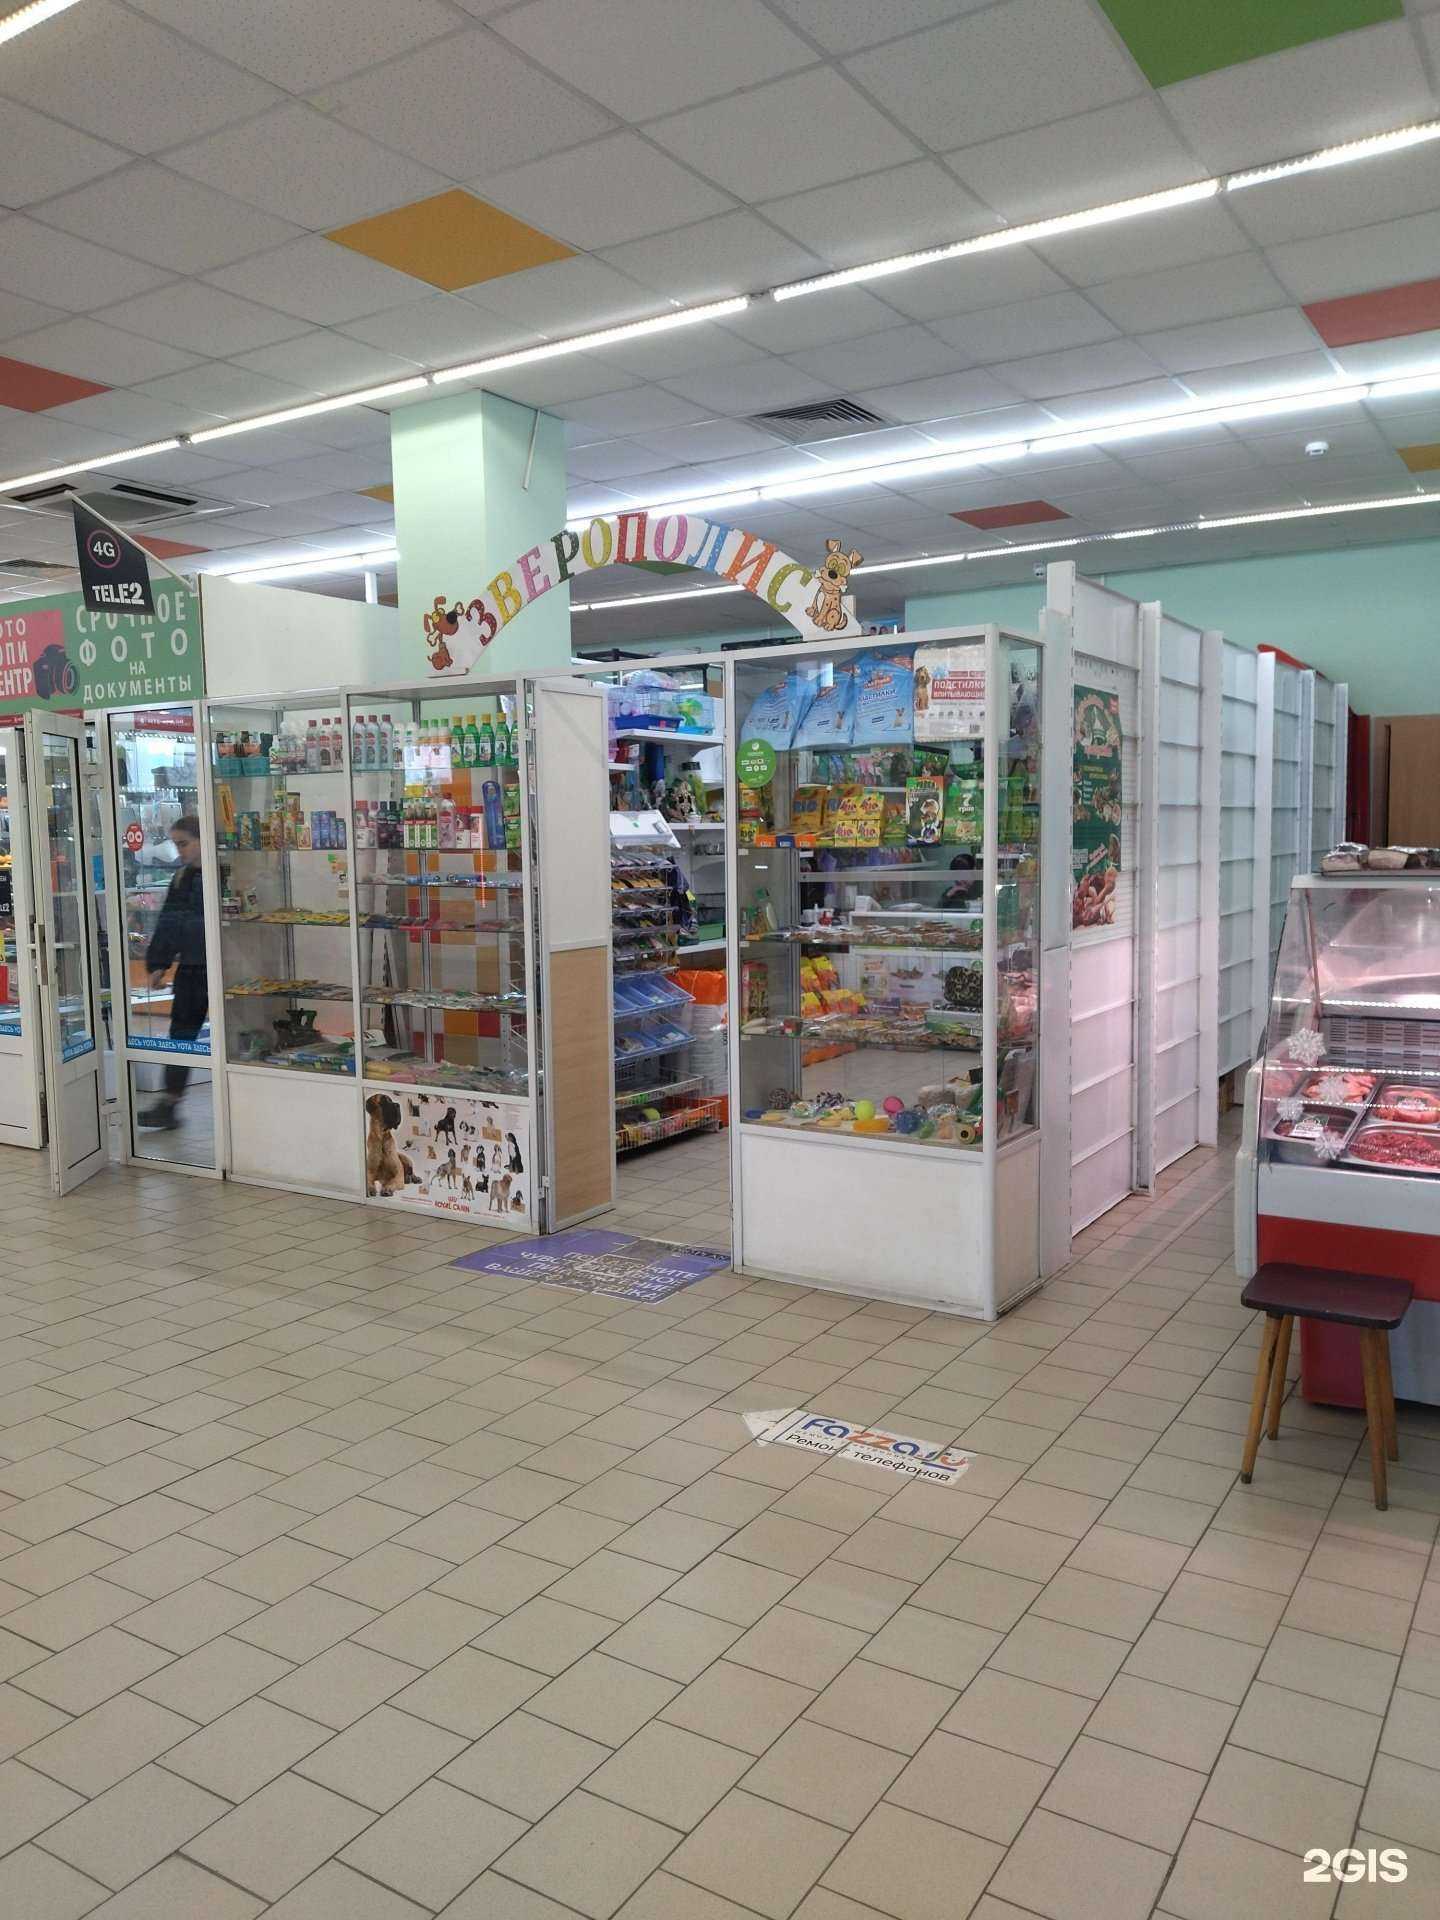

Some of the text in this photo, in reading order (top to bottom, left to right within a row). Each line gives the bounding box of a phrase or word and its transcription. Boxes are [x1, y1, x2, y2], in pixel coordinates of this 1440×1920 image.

[92, 541, 116, 558] 4G
[464, 511, 812, 646] ЗВЕРОПОЛИС
[92, 582, 145, 605] TELE2
[79, 628, 188, 667] ФОТО
[129, 660, 146, 676] НА
[83, 675, 192, 704] ДОКУМЕНТЫ
[786, 1433, 849, 1454] Ремон
[853, 1451, 951, 1481] телефонов
